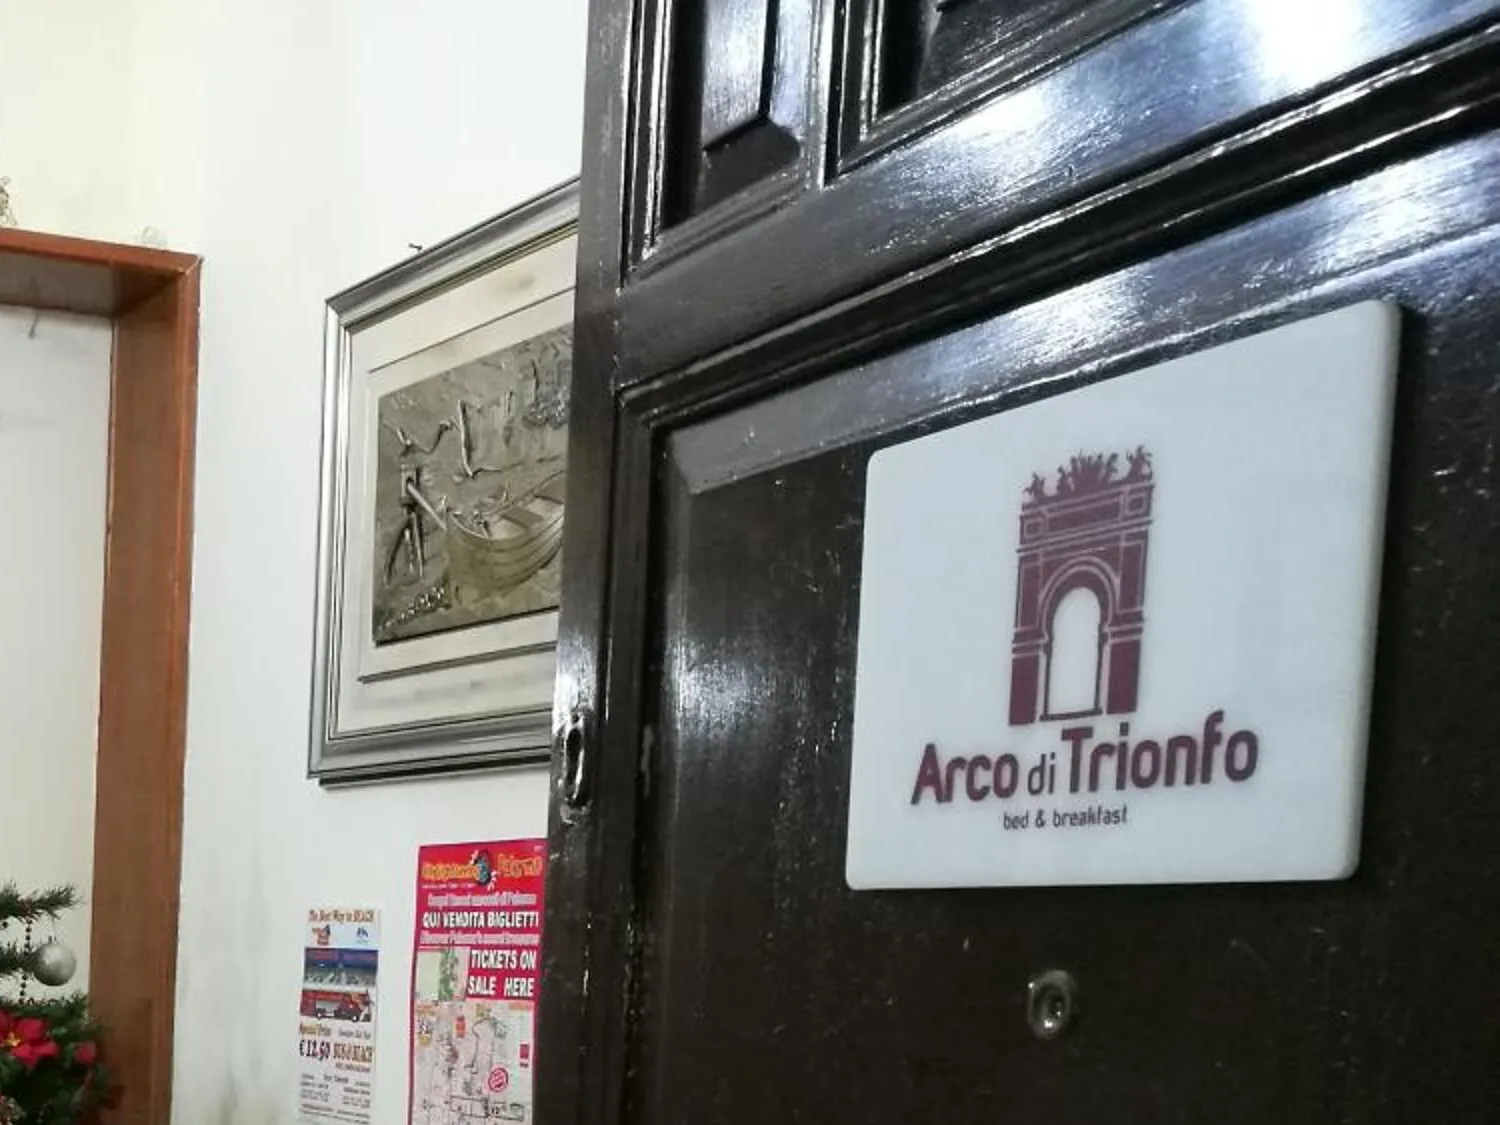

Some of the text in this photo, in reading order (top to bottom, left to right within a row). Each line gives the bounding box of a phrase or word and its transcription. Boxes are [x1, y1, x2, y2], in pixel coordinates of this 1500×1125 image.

[911, 709, 1259, 805] Arco di Trionfo
[1003, 806, 1128, 831] bed & breakfast
[423, 911, 539, 929] QUI VENDITA BIGLIETTI
[471, 949, 537, 969] TICKETS ON
[467, 976, 535, 997] SALE HERE
